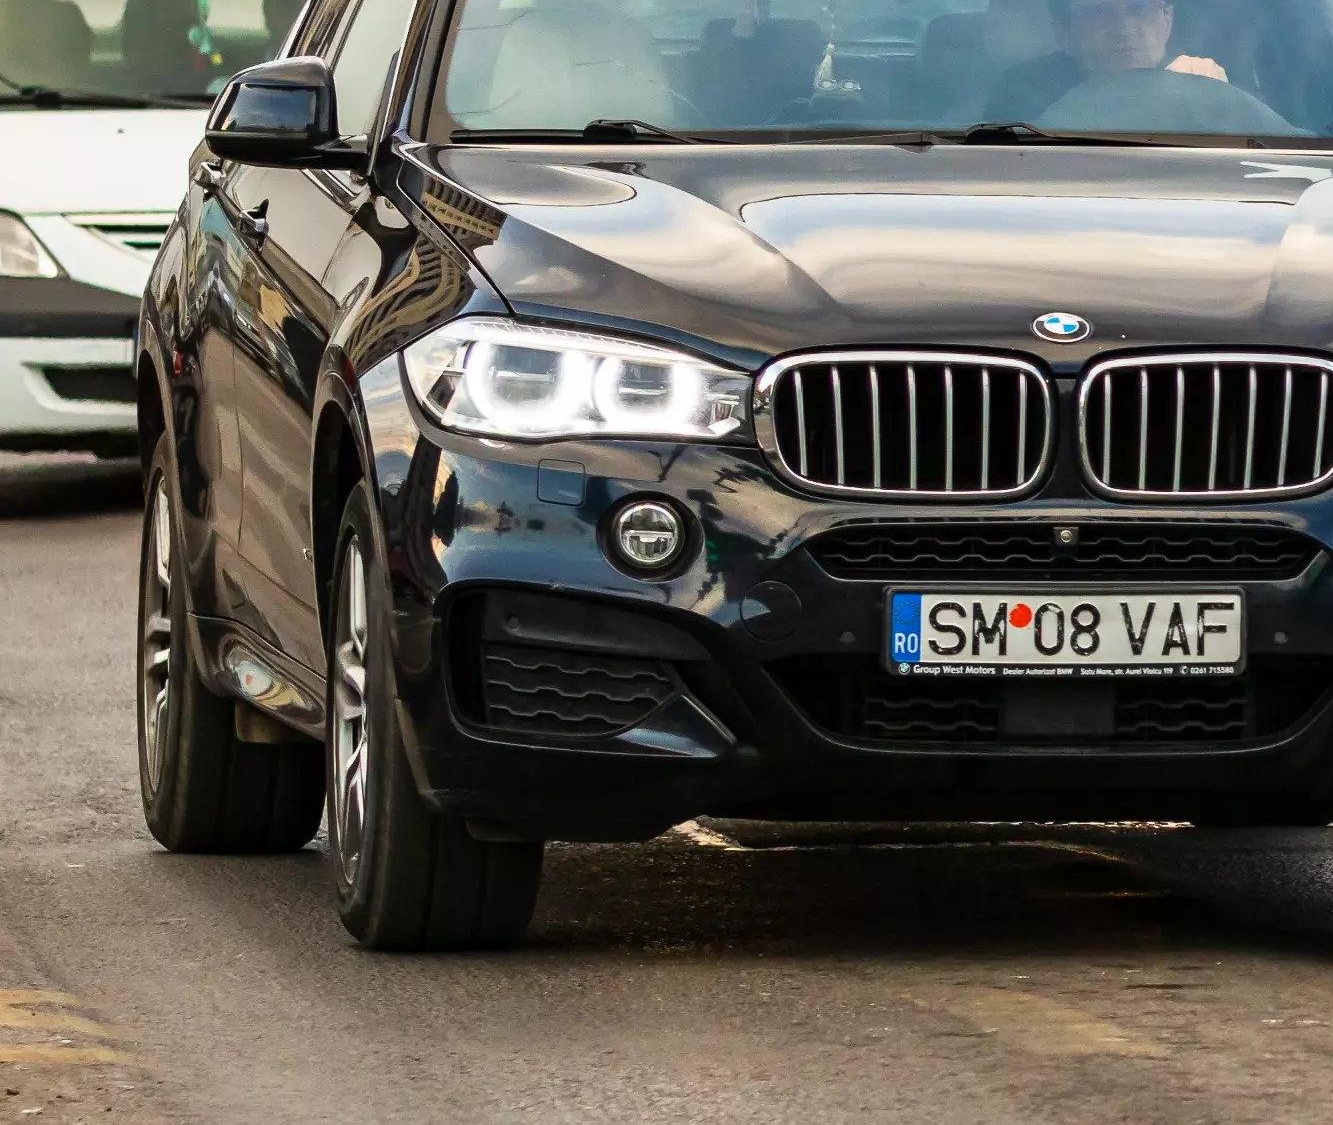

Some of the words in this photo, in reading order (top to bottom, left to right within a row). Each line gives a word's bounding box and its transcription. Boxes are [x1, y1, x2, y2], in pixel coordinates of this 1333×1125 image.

[928, 601, 1008, 656] SM
[1034, 602, 1101, 656] 08
[1119, 601, 1235, 656] VAF
[894, 632, 919, 654] RO
[913, 664, 941, 676] Group
[943, 665, 964, 674] West
[965, 666, 996, 674] Motors
[1002, 667, 1025, 675] Dealer
